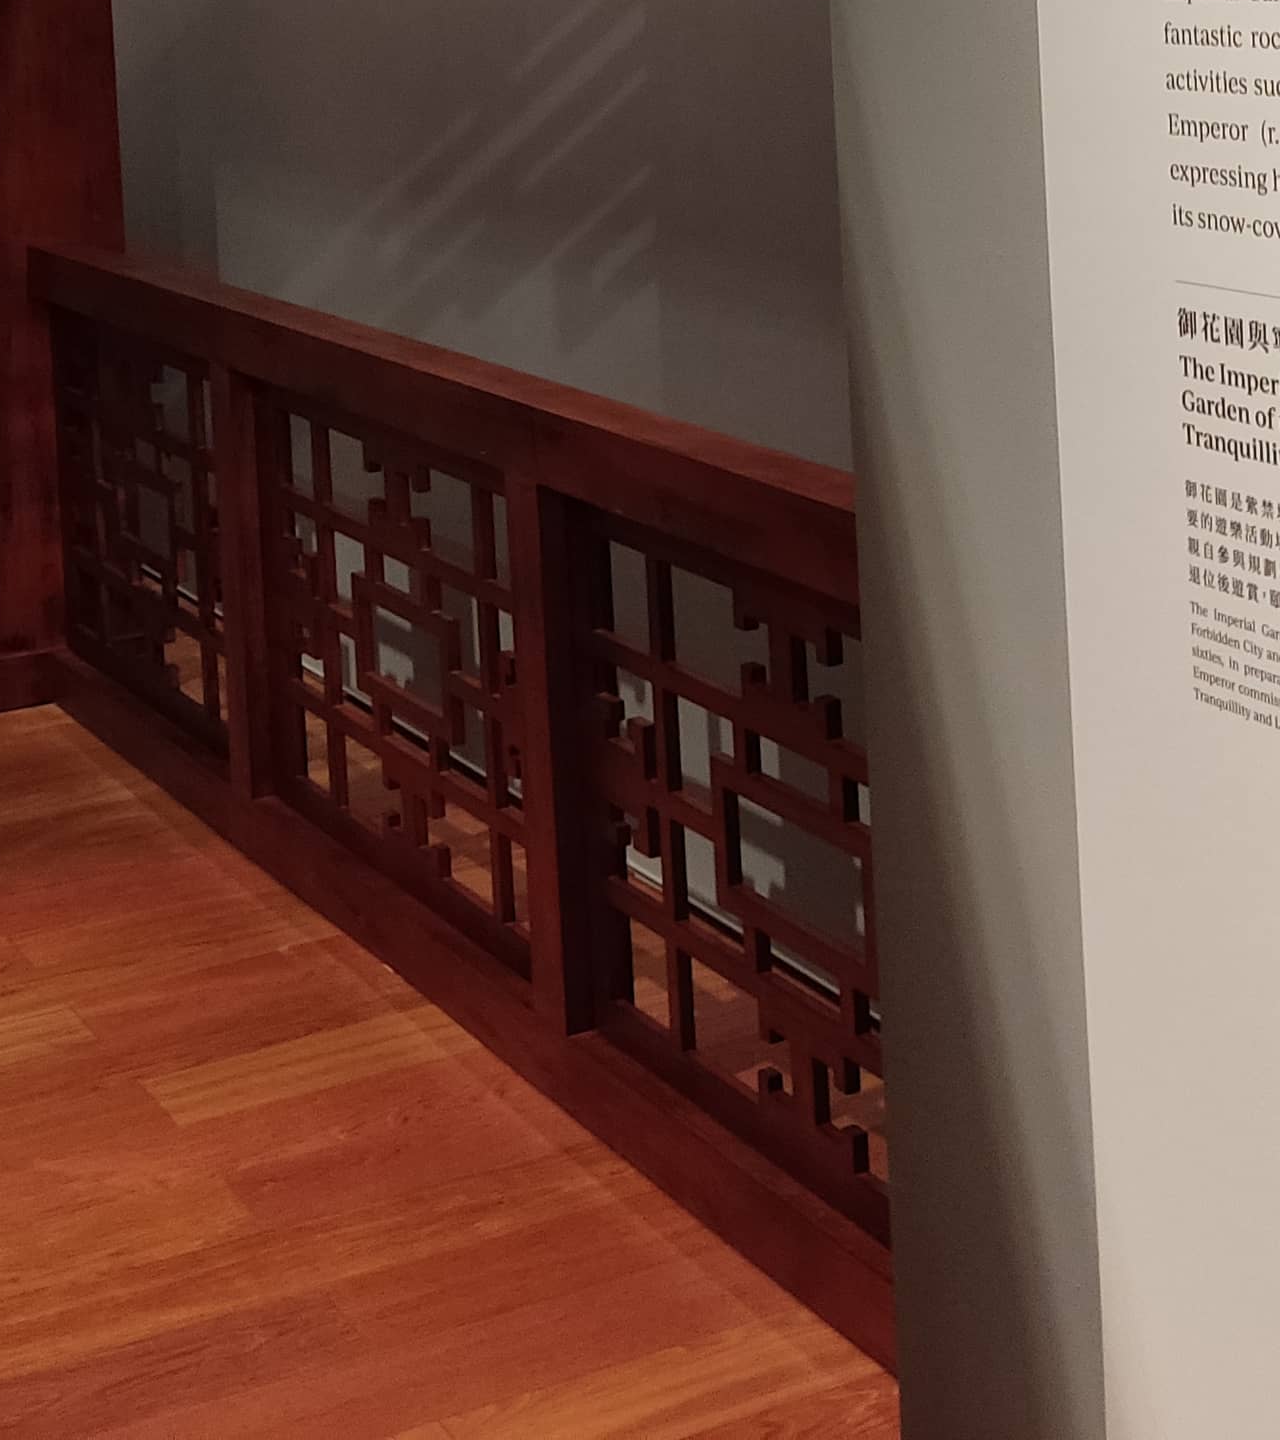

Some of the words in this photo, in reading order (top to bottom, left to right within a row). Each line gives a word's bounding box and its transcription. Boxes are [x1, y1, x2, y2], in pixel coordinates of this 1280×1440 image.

[1164, 21, 1243, 49] fantastic
[1166, 68, 1248, 95] activities
[1168, 113, 1249, 144] Emperor
[1261, 119, 1279, 147] (r.
[1170, 163, 1268, 196] expressing
[1172, 203, 1194, 228] its
[1179, 354, 1215, 383] The
[1181, 389, 1251, 425] Garden
[1255, 406, 1276, 430] of
[1189, 600, 1209, 618] The
[1213, 607, 1256, 634] Imperial
[1191, 622, 1241, 650] Forbidden
[1242, 639, 1264, 660] City
[1192, 686, 1251, 721] Tranquillity
[1253, 711, 1273, 727] and
